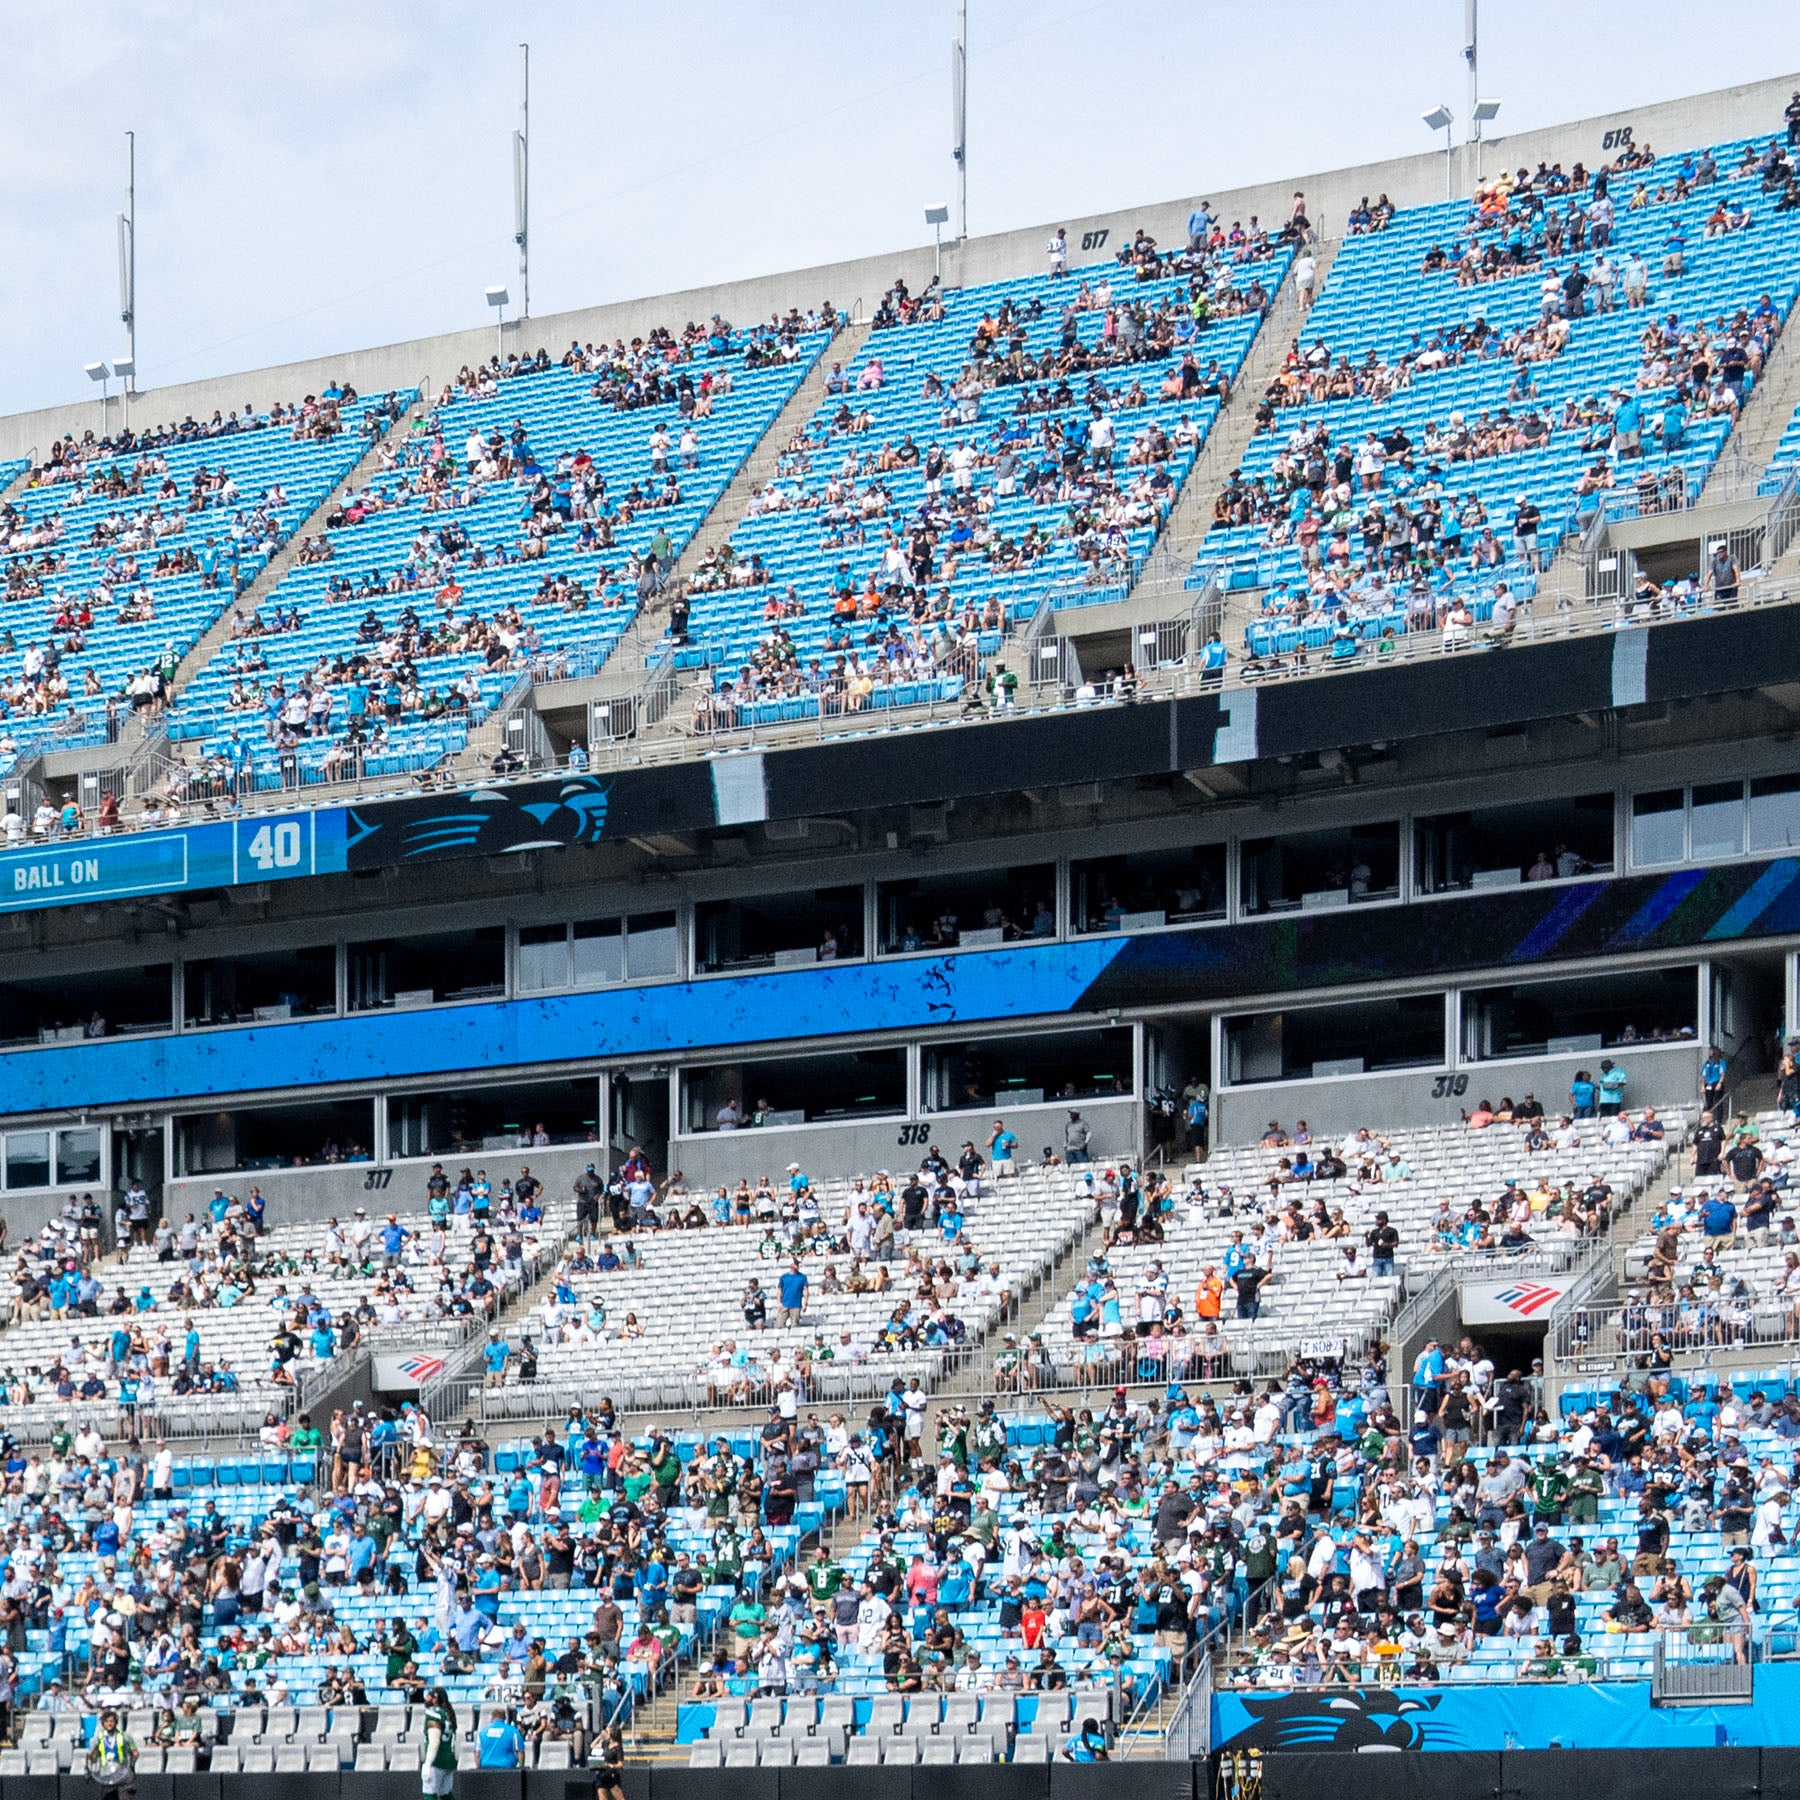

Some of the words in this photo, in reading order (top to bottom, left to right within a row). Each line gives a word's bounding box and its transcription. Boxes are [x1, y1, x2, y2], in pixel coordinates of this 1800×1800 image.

[1602, 127, 1633, 150] 518
[1081, 229, 1109, 251] 517
[248, 822, 300, 869] 40
[14, 861, 64, 891] BALL
[70, 857, 98, 885] ON
[1431, 1074, 1469, 1099] 319
[897, 1123, 931, 1146] 318
[363, 1169, 393, 1190] 317
